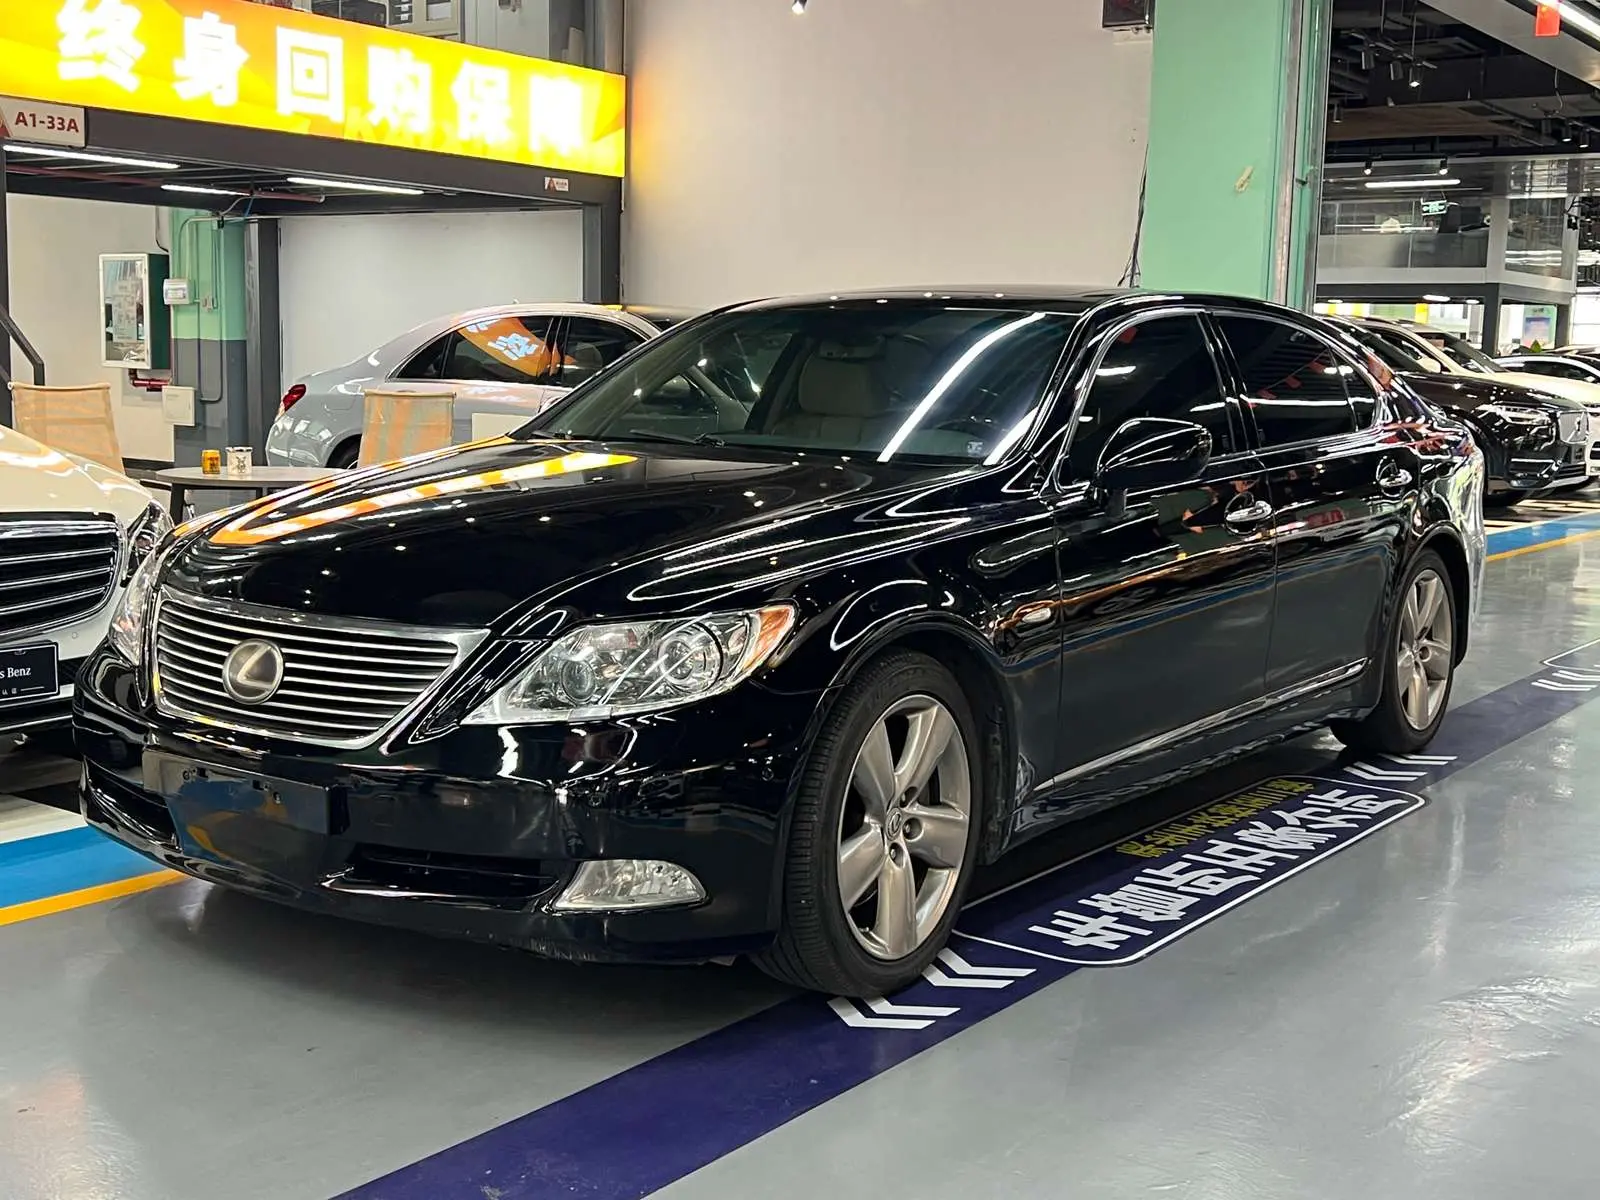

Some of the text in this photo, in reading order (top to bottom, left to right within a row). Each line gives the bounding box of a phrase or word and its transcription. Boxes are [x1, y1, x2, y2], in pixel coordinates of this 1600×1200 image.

[15, 111, 79, 133] A1-33A
[7, 667, 31, 678] Benz
[1028, 789, 1408, 950] 车管所五象分所
